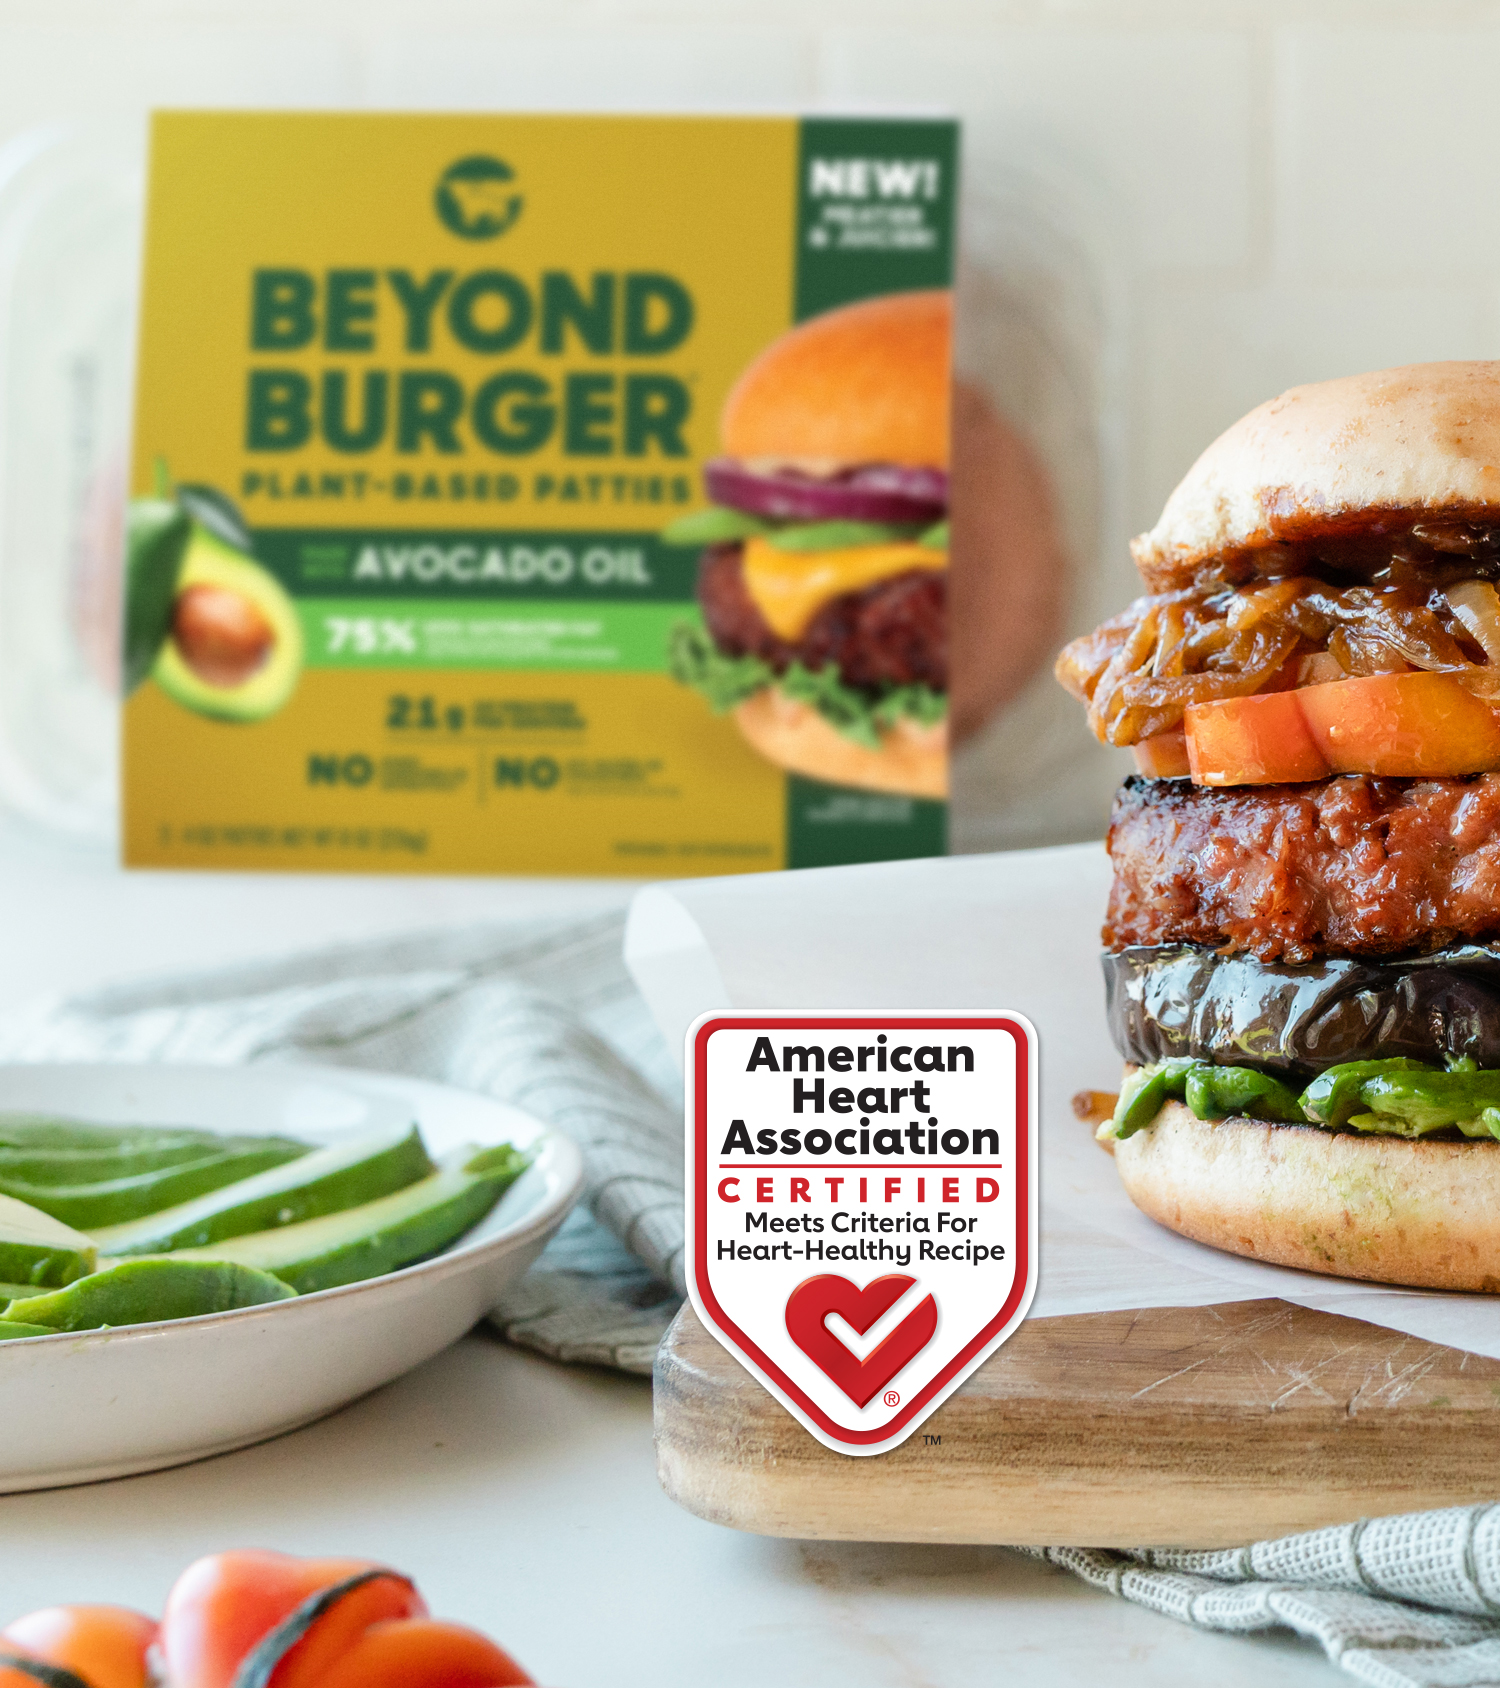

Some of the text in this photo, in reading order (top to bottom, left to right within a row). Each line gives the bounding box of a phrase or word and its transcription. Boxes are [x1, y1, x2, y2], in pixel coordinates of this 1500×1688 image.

[811, 160, 937, 198] NEW!
[248, 268, 696, 358] BEYOND
[244, 368, 692, 459] BURGER
[242, 472, 691, 504] PLANT-BASED PATTIES
[353, 545, 574, 582] AVOCADO
[580, 547, 651, 584] OIL
[307, 754, 375, 787] NO
[494, 757, 562, 790] NO
